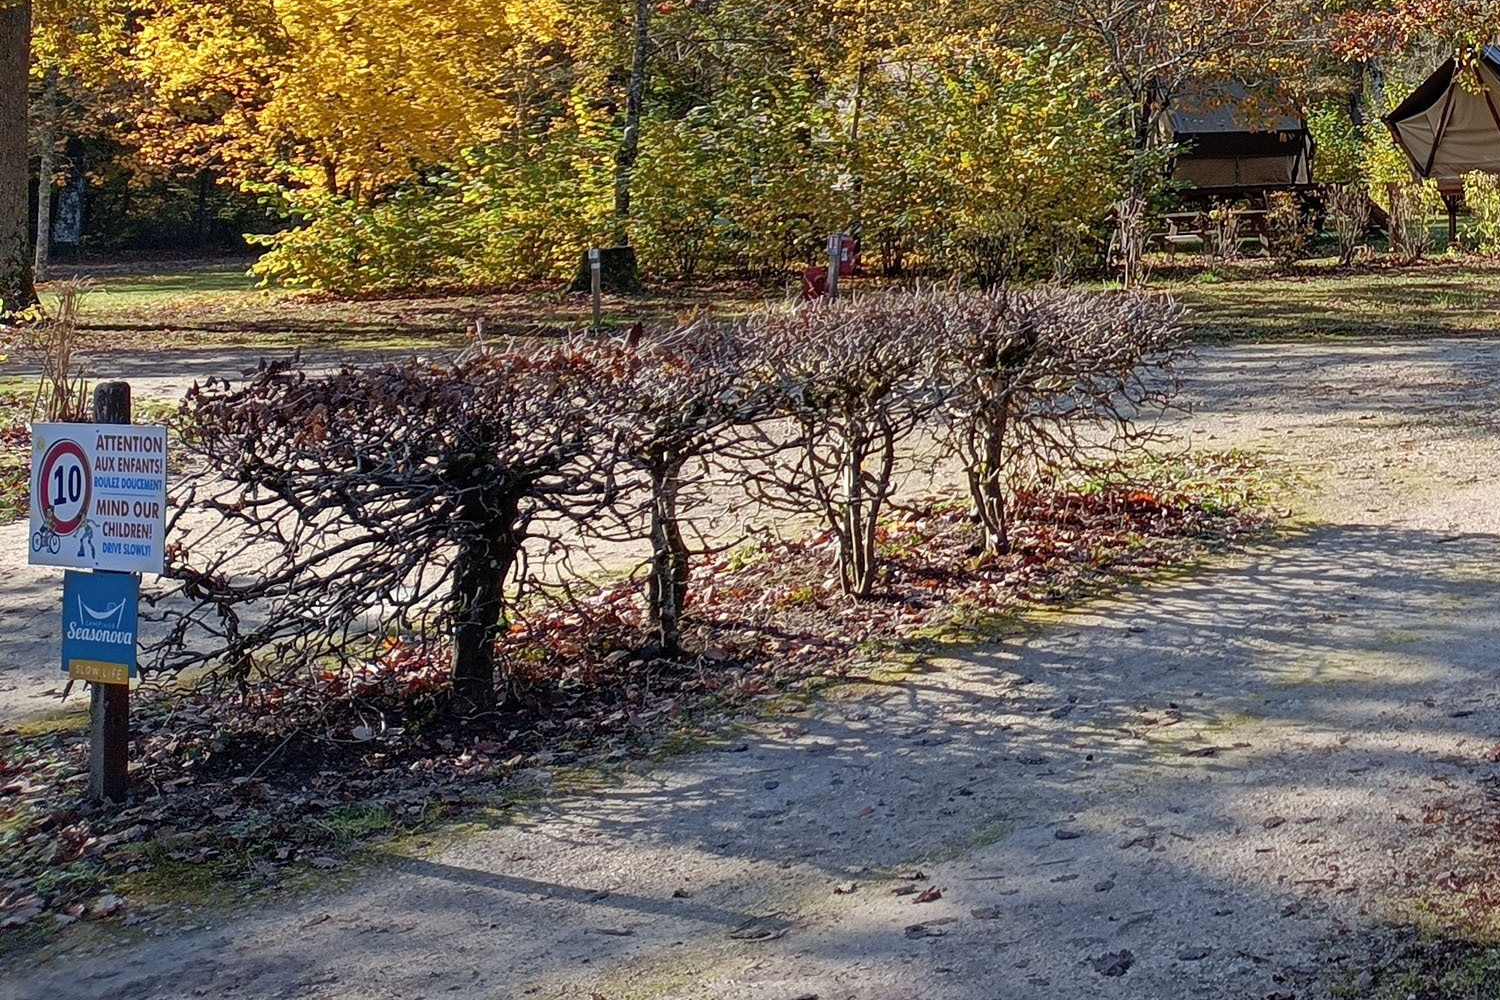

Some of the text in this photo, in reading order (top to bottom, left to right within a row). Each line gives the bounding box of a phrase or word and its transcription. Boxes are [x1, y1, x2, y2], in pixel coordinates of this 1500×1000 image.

[96, 434, 162, 453] ATTENTION
[95, 456, 163, 474] AUX ENFANTS!
[53, 465, 82, 506] 10
[94, 476, 162, 491] ROULEZ DOUCEMENT
[96, 499, 159, 519] MIND OUR
[102, 521, 152, 539] CHILDREN!
[102, 542, 151, 557] DRIVE SLOWLY!
[67, 621, 132, 645] Seasonova
[75, 664, 122, 681] SLOW LIFE
